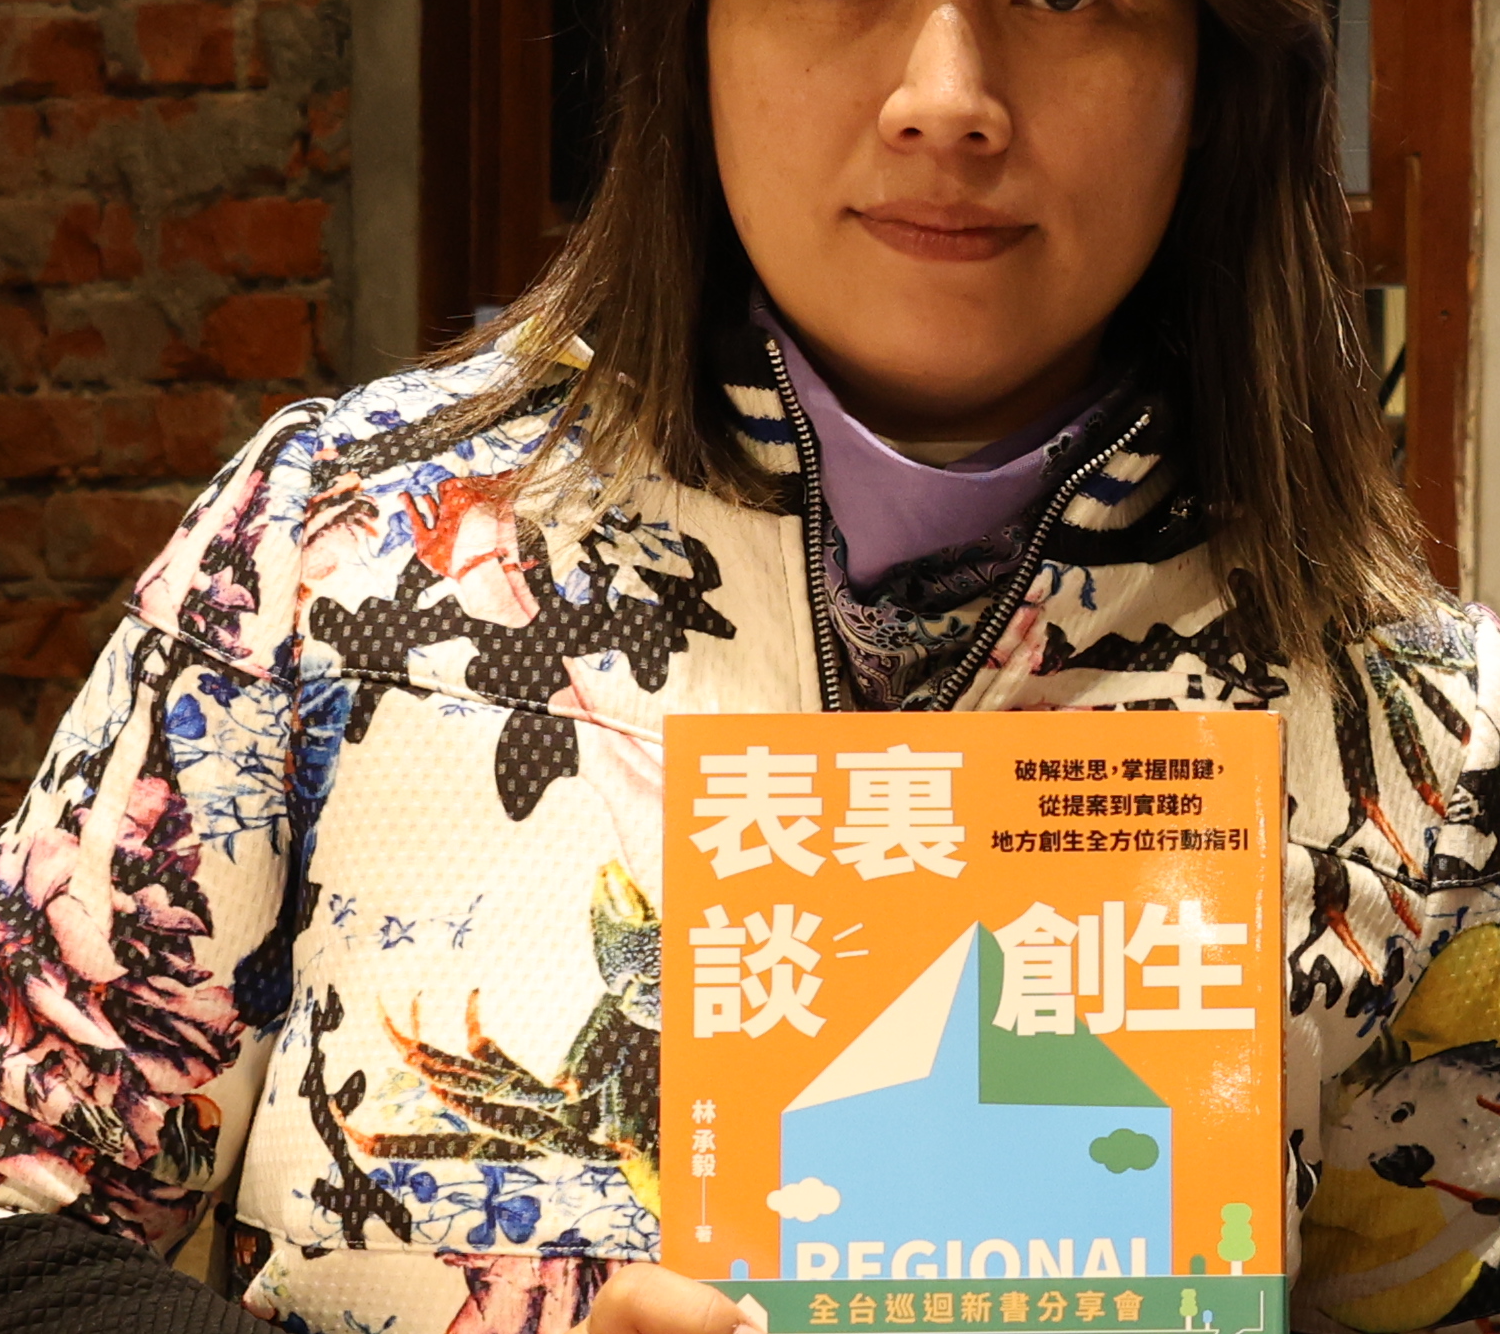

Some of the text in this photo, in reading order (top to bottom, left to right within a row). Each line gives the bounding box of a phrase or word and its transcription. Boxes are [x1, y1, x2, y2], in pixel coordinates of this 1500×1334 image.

[689, 744, 968, 882] 表裏
[990, 827, 1250, 853] 地方創生全方位行動指引
[1038, 793, 1203, 818] 從提案到實踐的
[688, 899, 1257, 1040] 談 創生
[691, 1099, 717, 1243] 林承毅 著
[808, 1289, 1145, 1325] 全台巡迴新書分享會
